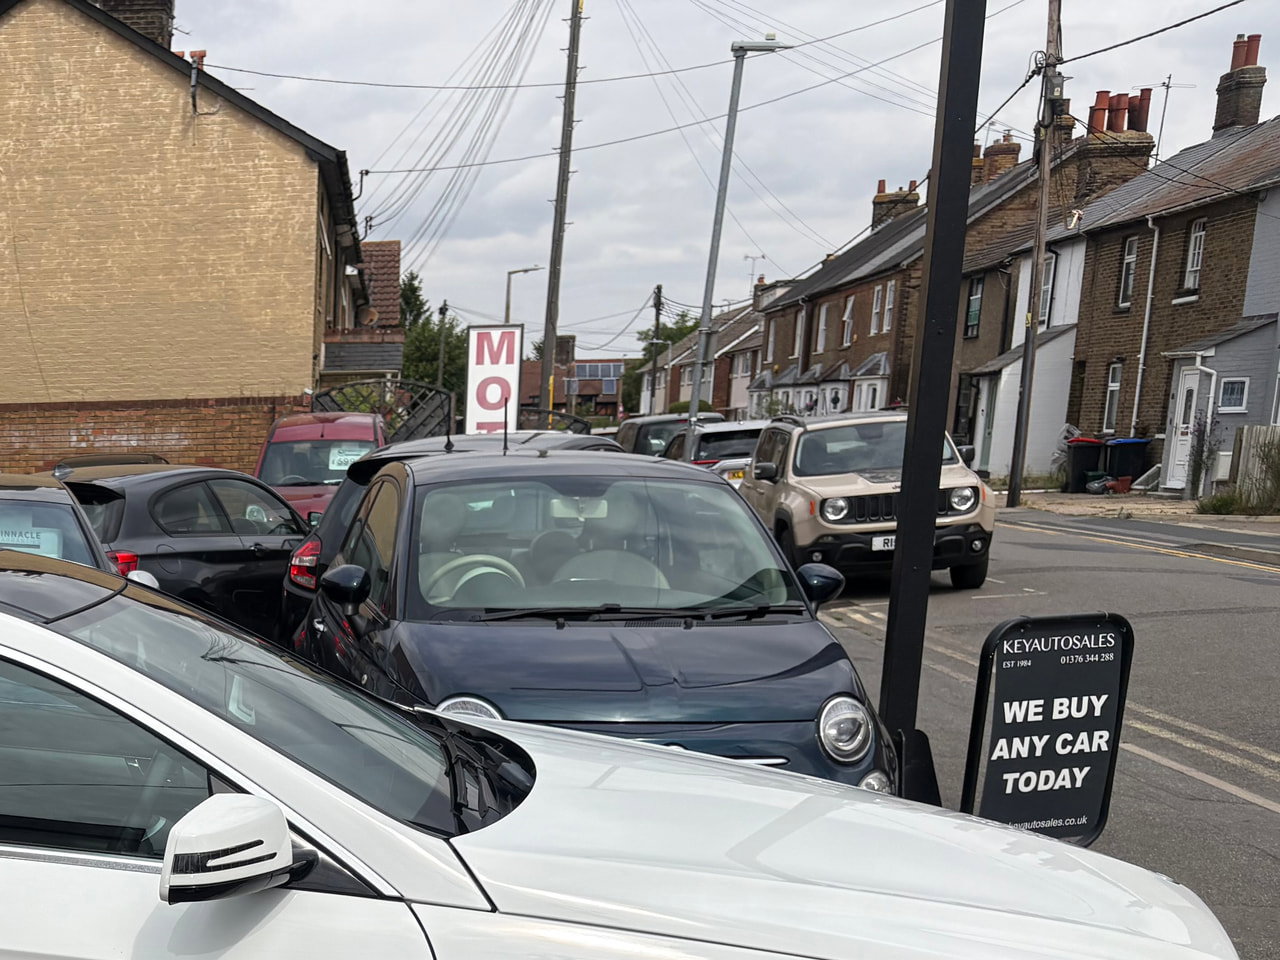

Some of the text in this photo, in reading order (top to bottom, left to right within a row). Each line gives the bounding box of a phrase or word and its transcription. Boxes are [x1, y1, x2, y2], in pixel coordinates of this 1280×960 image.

[1002, 633, 1116, 654] KEYAUTOSALES
[1002, 660, 1032, 669] EST 1984
[1060, 652, 1115, 665] 01376 344 288
[1003, 694, 1109, 724] WE BUY
[991, 730, 1110, 760] ANY CAR
[1002, 766, 1092, 794] TODAY
